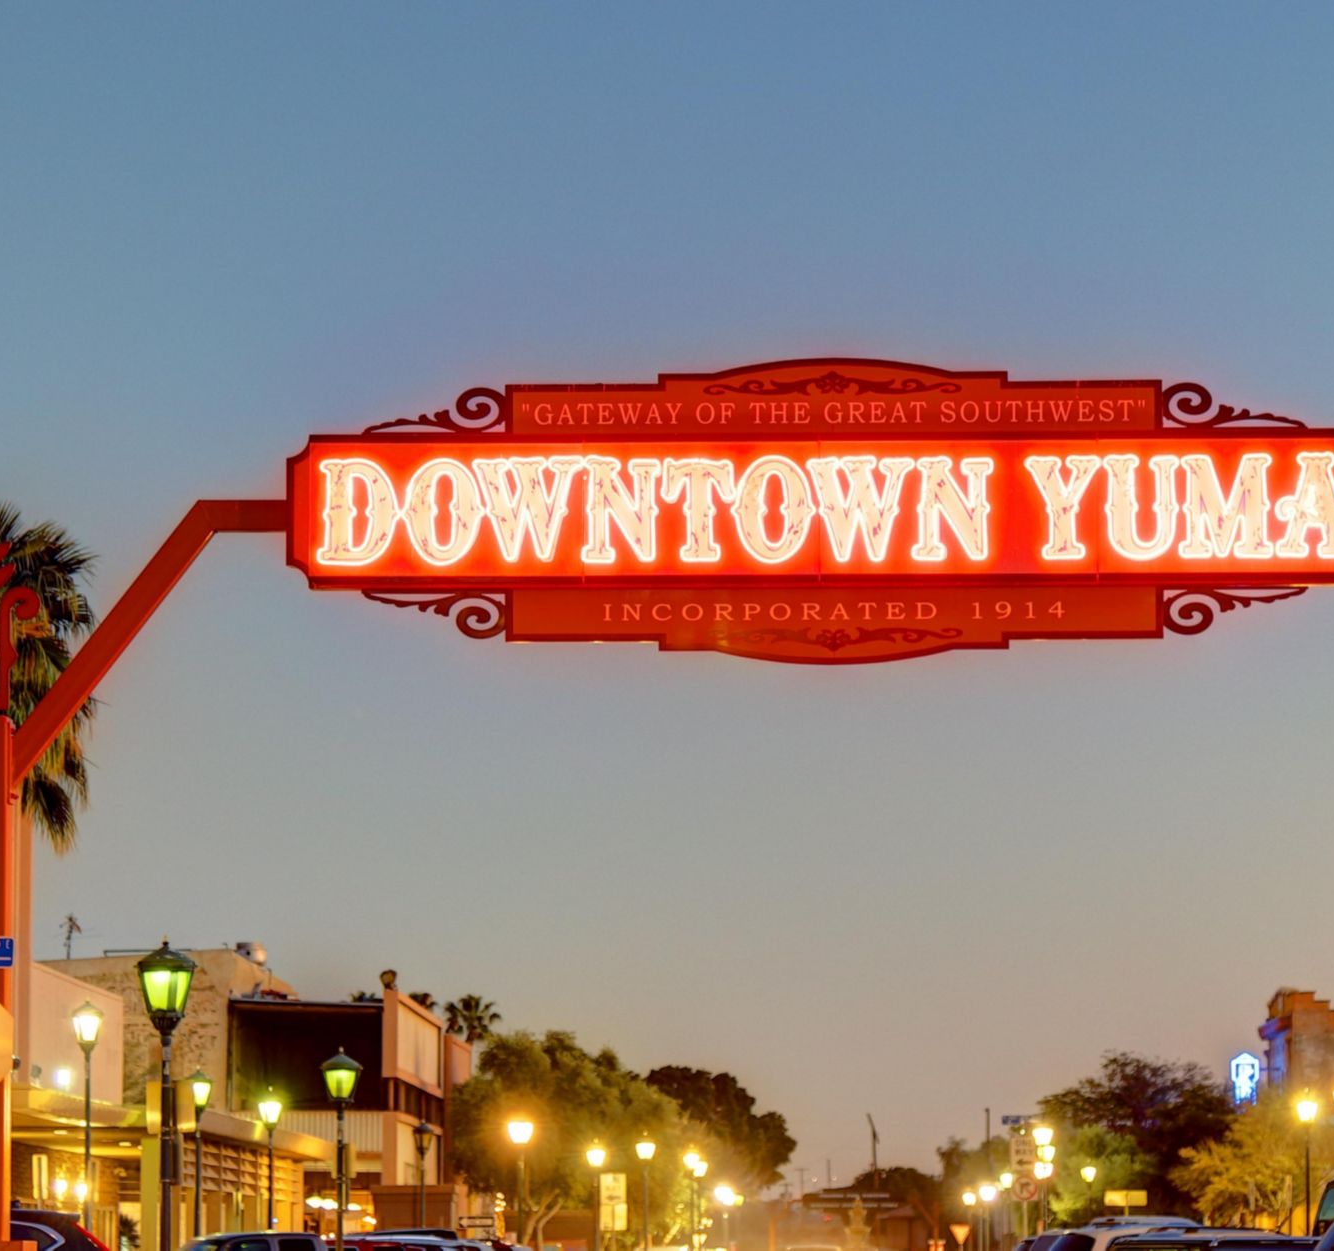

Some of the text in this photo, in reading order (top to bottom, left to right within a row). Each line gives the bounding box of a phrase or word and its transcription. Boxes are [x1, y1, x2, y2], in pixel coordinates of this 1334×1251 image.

[522, 399, 1146, 425] "GATEWAY OF THE GREAT SOUTHWEST"
[316, 455, 995, 566] DOWNTOWN
[602, 600, 1067, 622] INCORPORATED 1914
[5, 940, 11, 949] E
